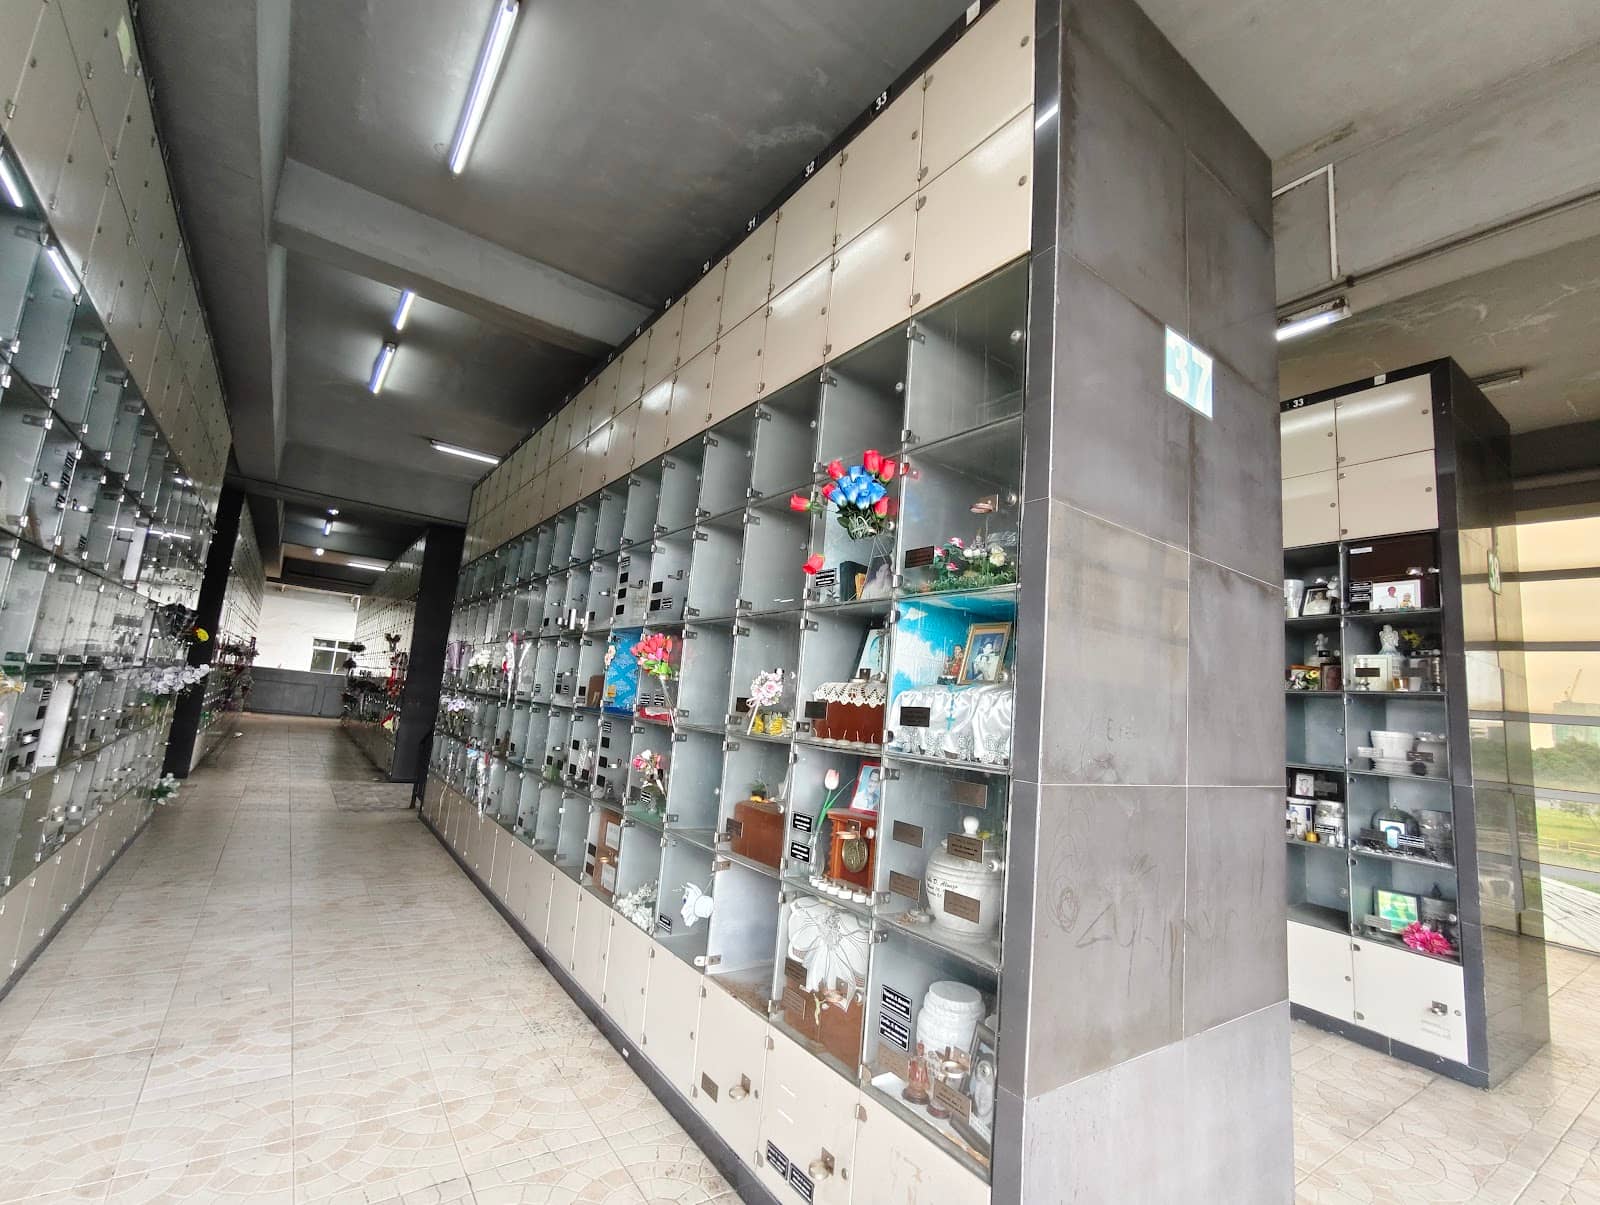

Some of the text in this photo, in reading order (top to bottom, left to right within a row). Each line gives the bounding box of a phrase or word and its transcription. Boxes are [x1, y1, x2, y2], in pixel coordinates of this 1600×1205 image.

[876, 91, 887, 110] 33
[805, 160, 815, 177] 32
[747, 216, 756, 231] 31
[1166, 329, 1213, 416] 37
[1292, 398, 1305, 408] 33
